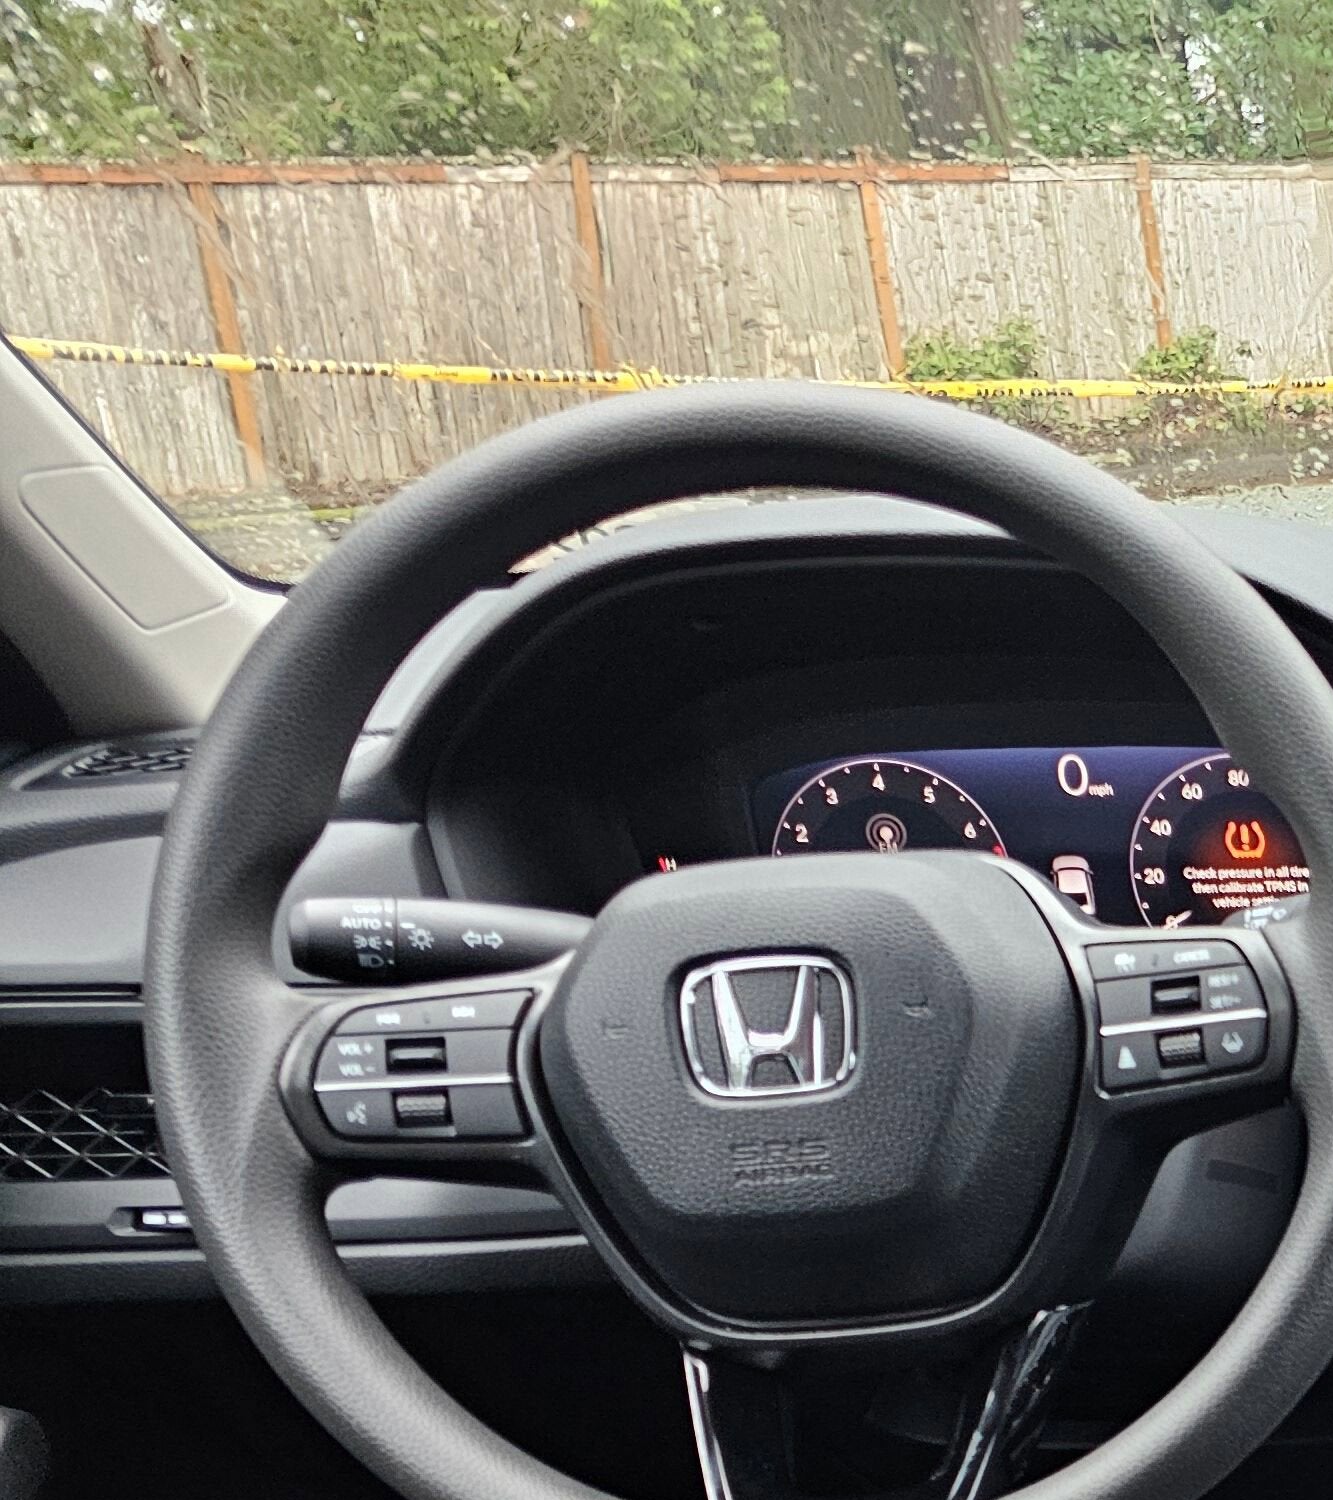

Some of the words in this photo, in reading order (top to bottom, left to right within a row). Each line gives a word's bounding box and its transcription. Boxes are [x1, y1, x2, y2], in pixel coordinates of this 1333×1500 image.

[872, 773, 886, 792] 4
[1057, 753, 1089, 797] 0
[1088, 782, 1114, 798] mph
[1227, 768, 1250, 787] 80
[825, 787, 839, 806] 3
[923, 785, 936, 804] 5
[1181, 782, 1204, 801] 60
[795, 823, 809, 843] 2
[964, 821, 977, 840] 6
[1149, 818, 1172, 837] 40
[1143, 867, 1166, 885] 20
[1182, 866, 1218, 880] Check
[1218, 866, 1263, 883] pressure
[1263, 865, 1275, 878] in
[1275, 865, 1290, 878] all
[1290, 865, 1310, 879] tire
[1192, 881, 1218, 895] then
[1218, 880, 1265, 894] calibrate
[1264, 879, 1297, 894] TPMS
[1297, 880, 1310, 893] in
[1212, 895, 1251, 909] vehicle
[340, 915, 383, 930] AUTO
